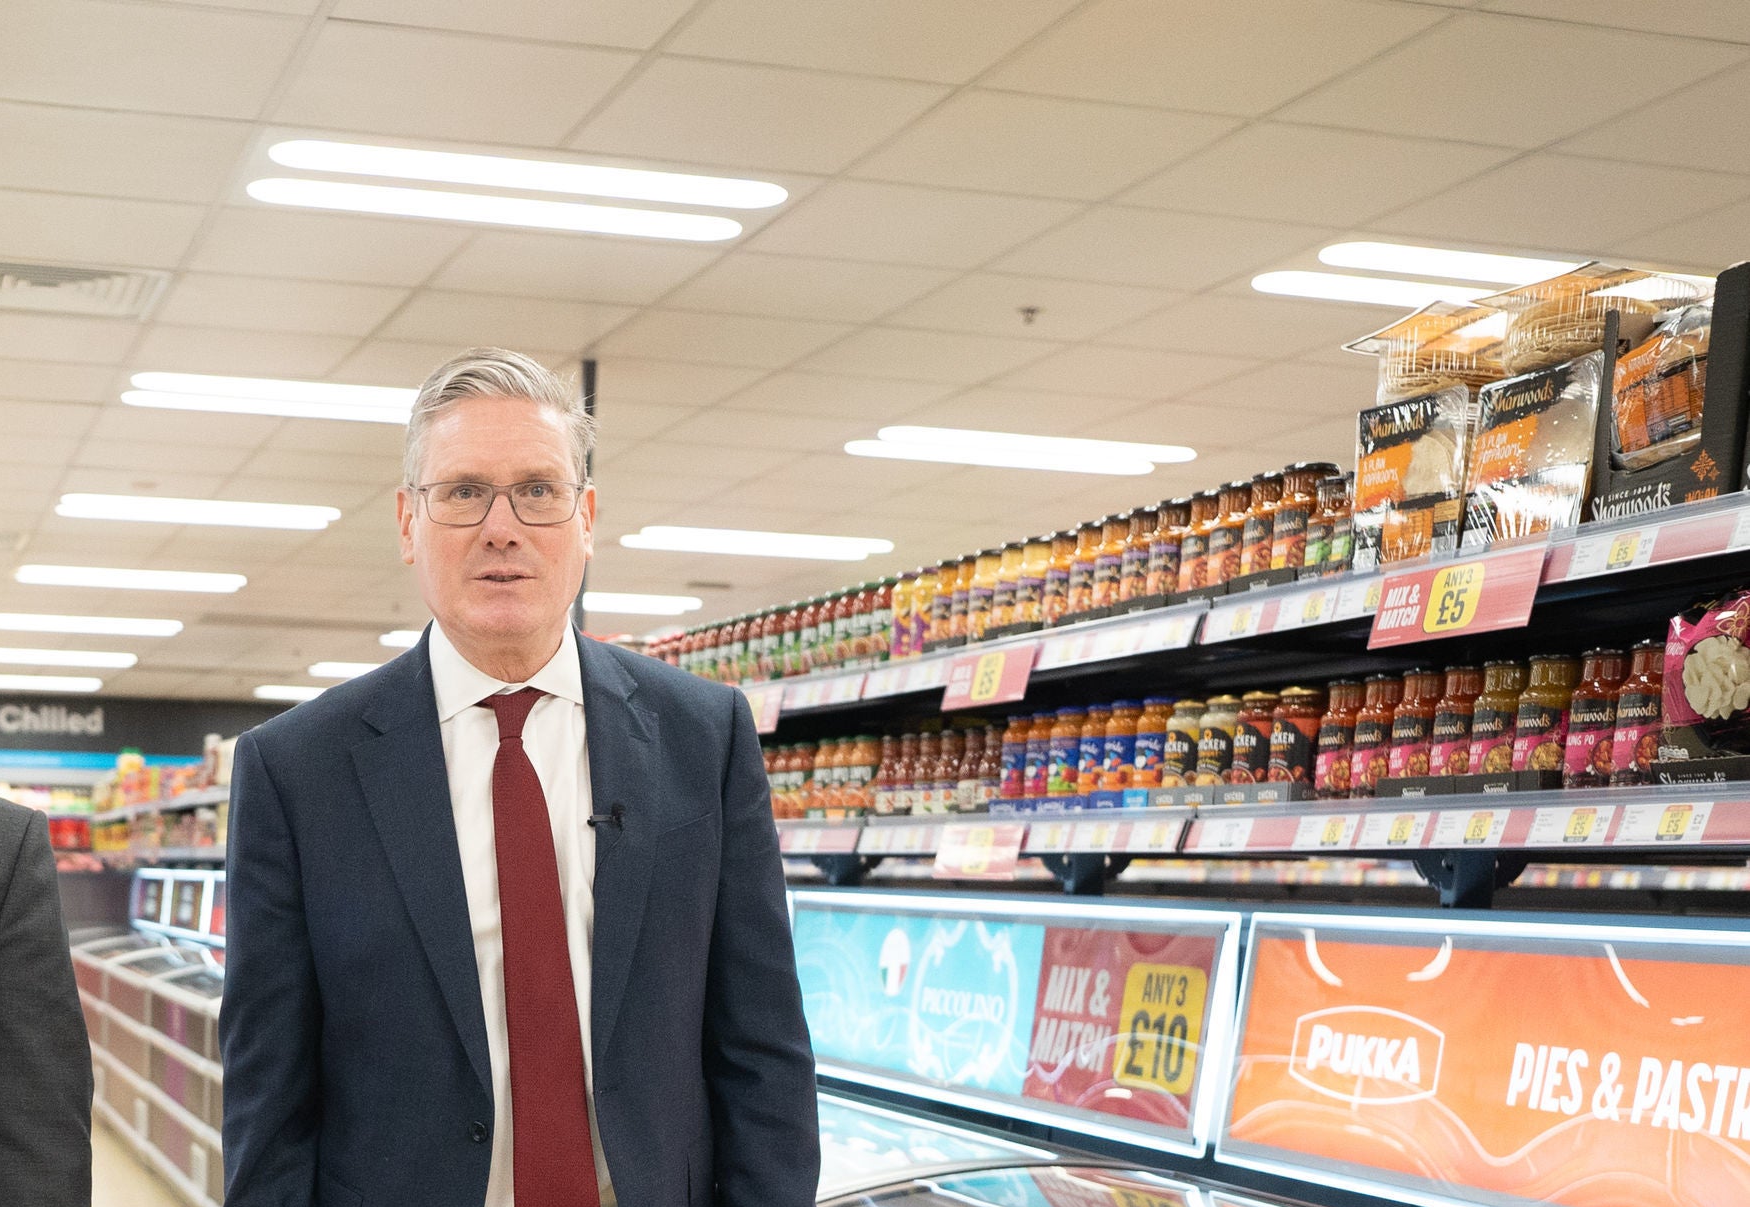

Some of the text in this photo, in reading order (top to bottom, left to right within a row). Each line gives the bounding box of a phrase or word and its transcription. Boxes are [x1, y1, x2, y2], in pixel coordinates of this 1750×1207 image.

[1591, 482, 1672, 521] Sharwood's
[1608, 490, 1628, 501] SINCE
[1384, 583, 1421, 609] MIX &
[1443, 569, 1474, 588] ANY 3
[1377, 605, 1421, 631] MATCH
[1435, 588, 1468, 626] £5
[1570, 706, 1616, 723] harwood's
[1617, 702, 1658, 718] harwood's
[1666, 820, 1680, 834] £5
[1042, 965, 1111, 1018] MIX &
[1141, 972, 1188, 1007] ANY 3
[1030, 1017, 1112, 1073] MATCH
[1125, 1010, 1188, 1084] £10
[1306, 1024, 1420, 1084] PUKKA
[1506, 1043, 1588, 1115] PIES
[1592, 1052, 1624, 1121] &
